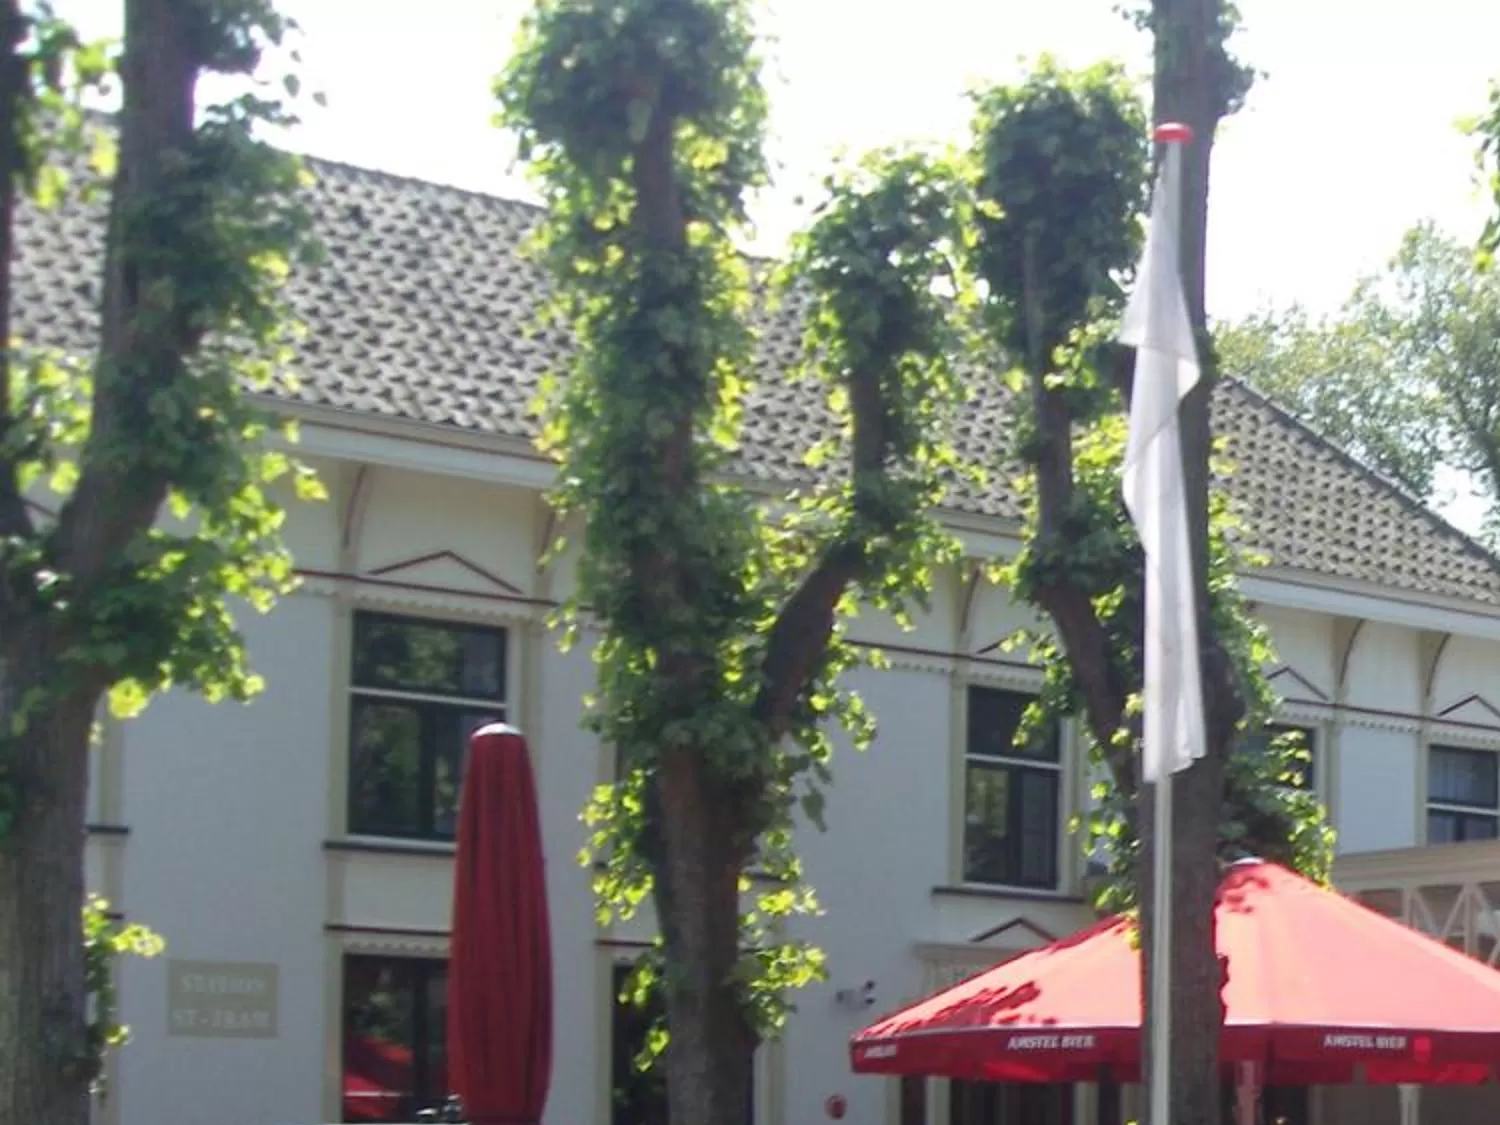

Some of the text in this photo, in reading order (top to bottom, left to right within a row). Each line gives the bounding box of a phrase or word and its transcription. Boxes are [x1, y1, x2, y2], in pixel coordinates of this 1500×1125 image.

[1007, 1036, 1059, 1050] AMSTEL
[1323, 1034, 1406, 1049] AMSTEL BIER
